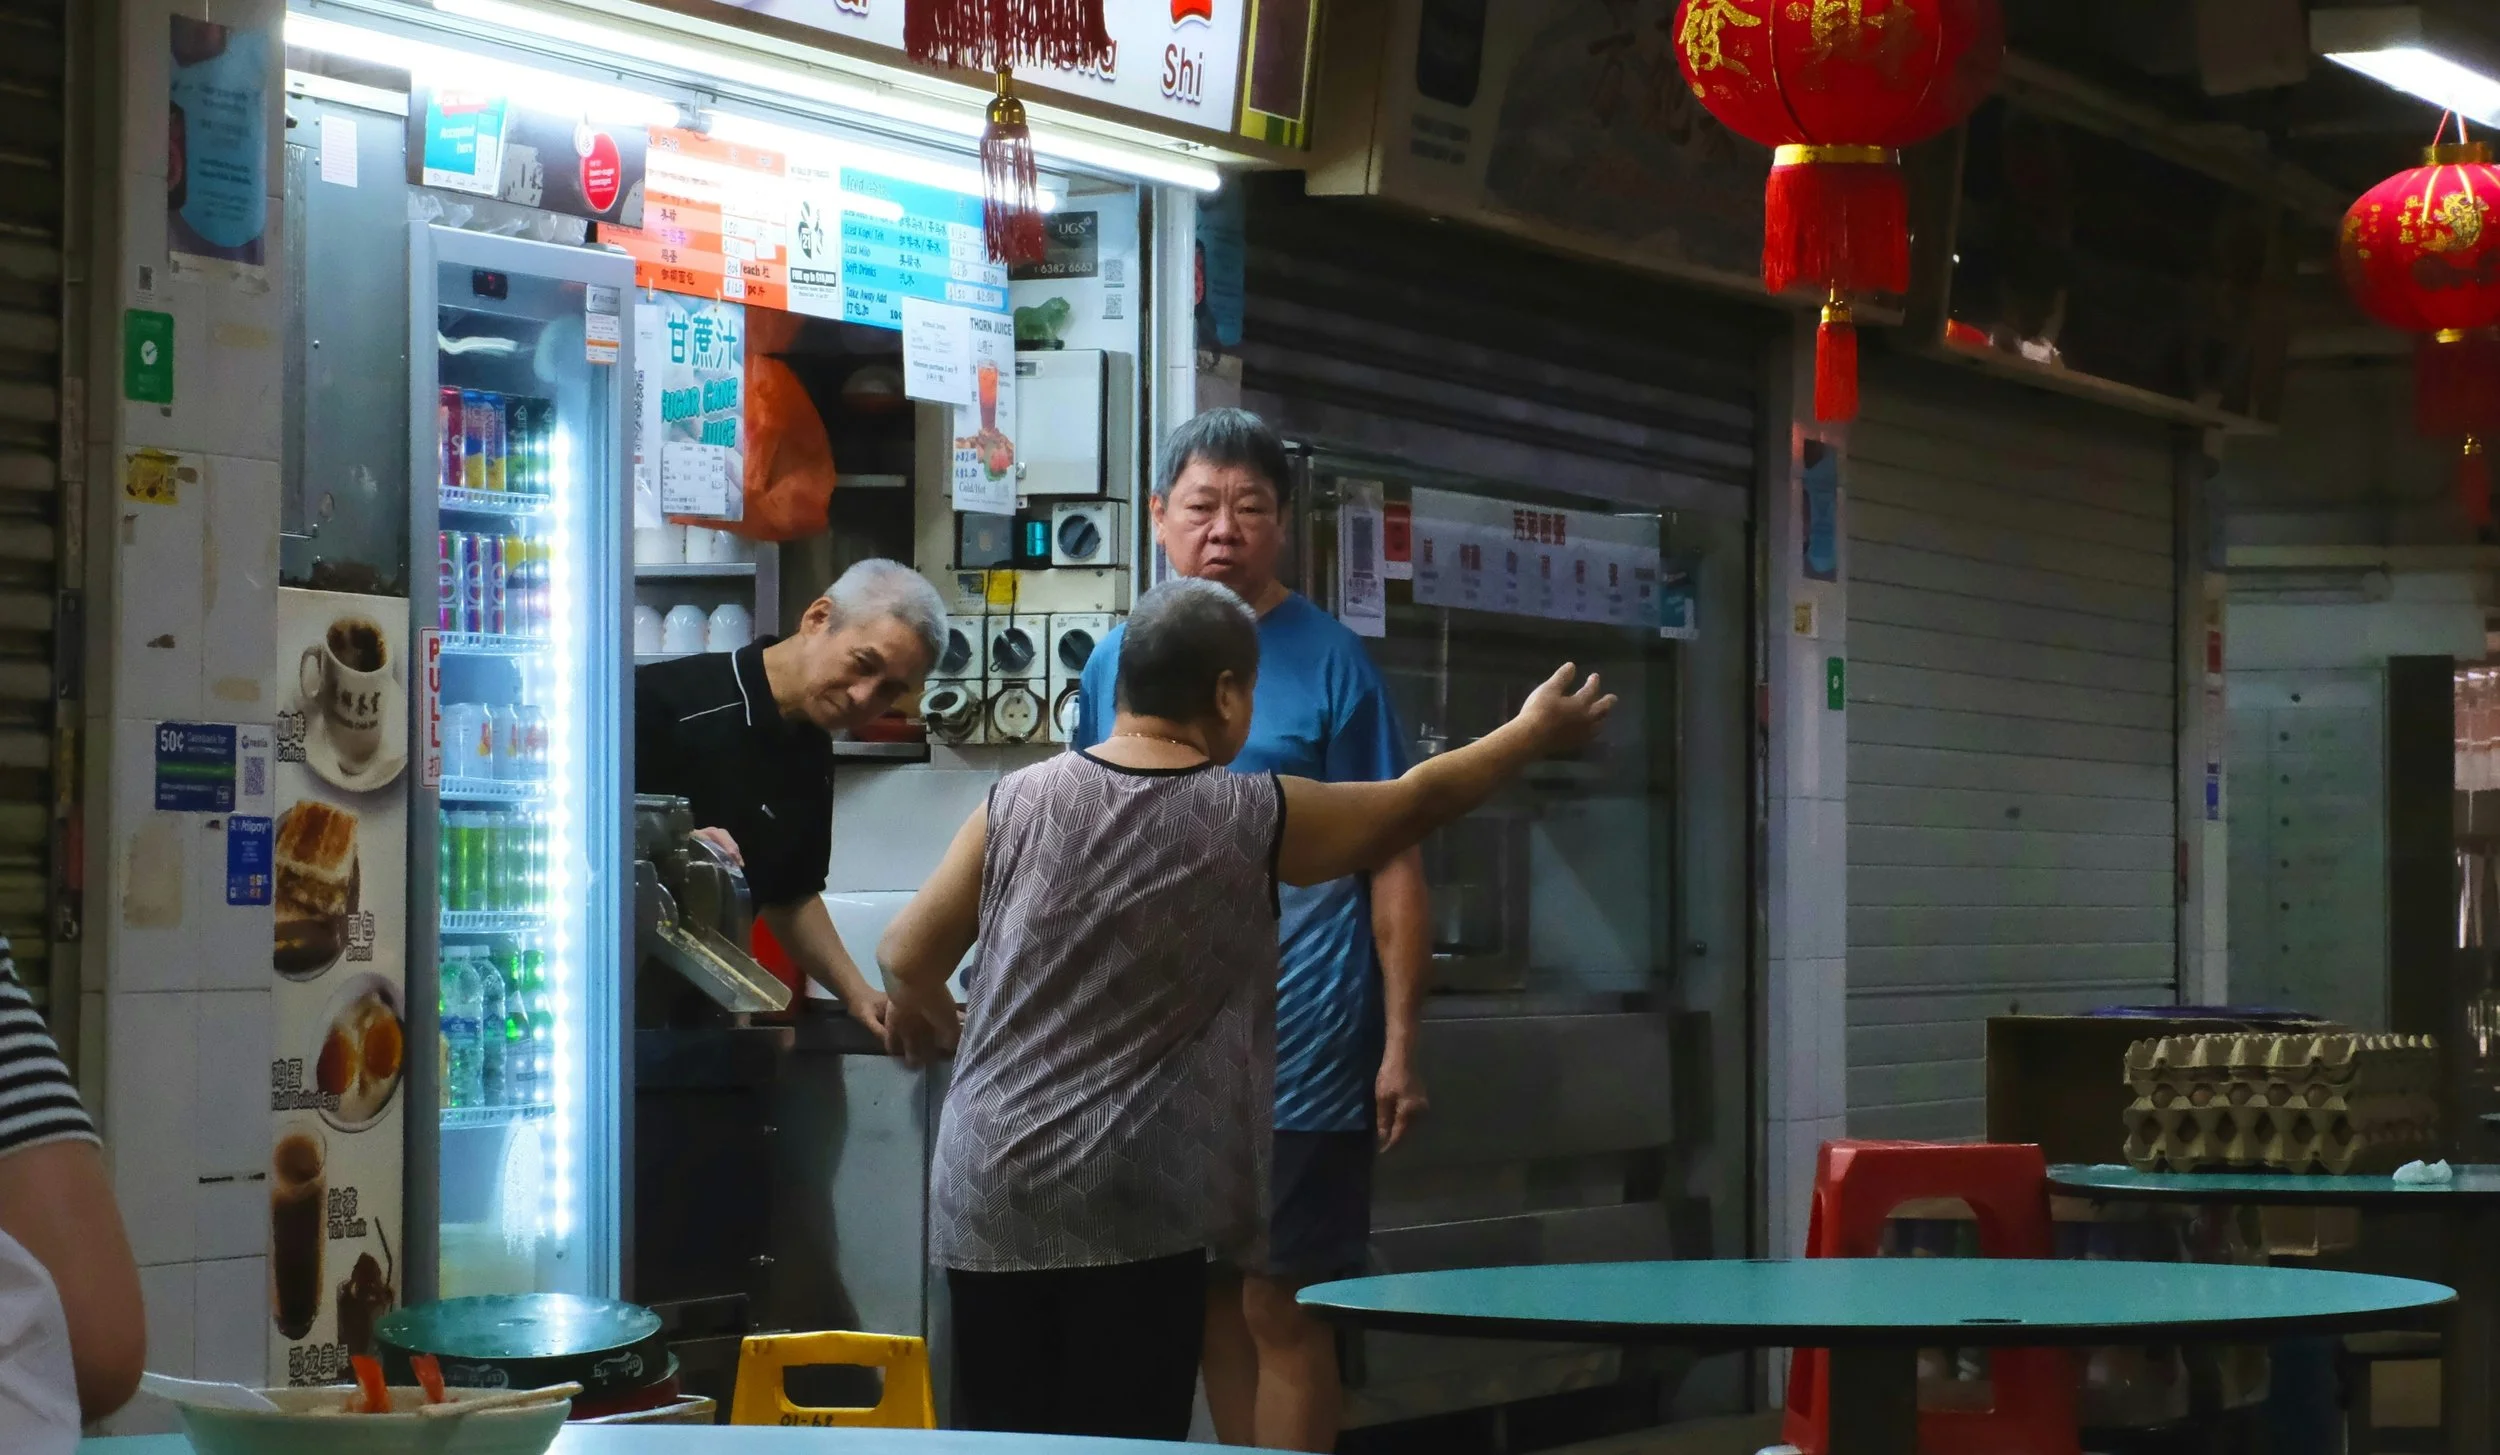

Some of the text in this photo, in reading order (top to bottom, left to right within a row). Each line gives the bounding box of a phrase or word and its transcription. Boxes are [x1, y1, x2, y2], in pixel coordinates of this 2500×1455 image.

[1163, 43, 1203, 97] Shi
[1058, 222, 1086, 235] UGS
[844, 244, 872, 257] Iced Milo
[845, 262, 877, 278] Soft Drinks
[1040, 264, 1064, 274] 6382
[846, 286, 859, 299] Take
[860, 289, 875, 303] Away
[876, 292, 888, 304] Add
[994, 322, 1013, 336] JUICE
[668, 312, 738, 371] 甘蔗汁
[662, 385, 701, 423] SUGAR
[703, 377, 738, 414] CANE
[701, 417, 737, 447] JUICE
[428, 637, 441, 748] PULL
[277, 710, 306, 742] 咖啡
[160, 729, 185, 752] 50¢
[277, 743, 306, 762] Coffee
[348, 911, 375, 942] 面包
[346, 944, 373, 962] Bread
[272, 1058, 303, 1090] 鸡蛋
[321, 1092, 340, 1112] Egg
[328, 1187, 357, 1219] 拉茶
[328, 1218, 367, 1239] Teh Tarik
